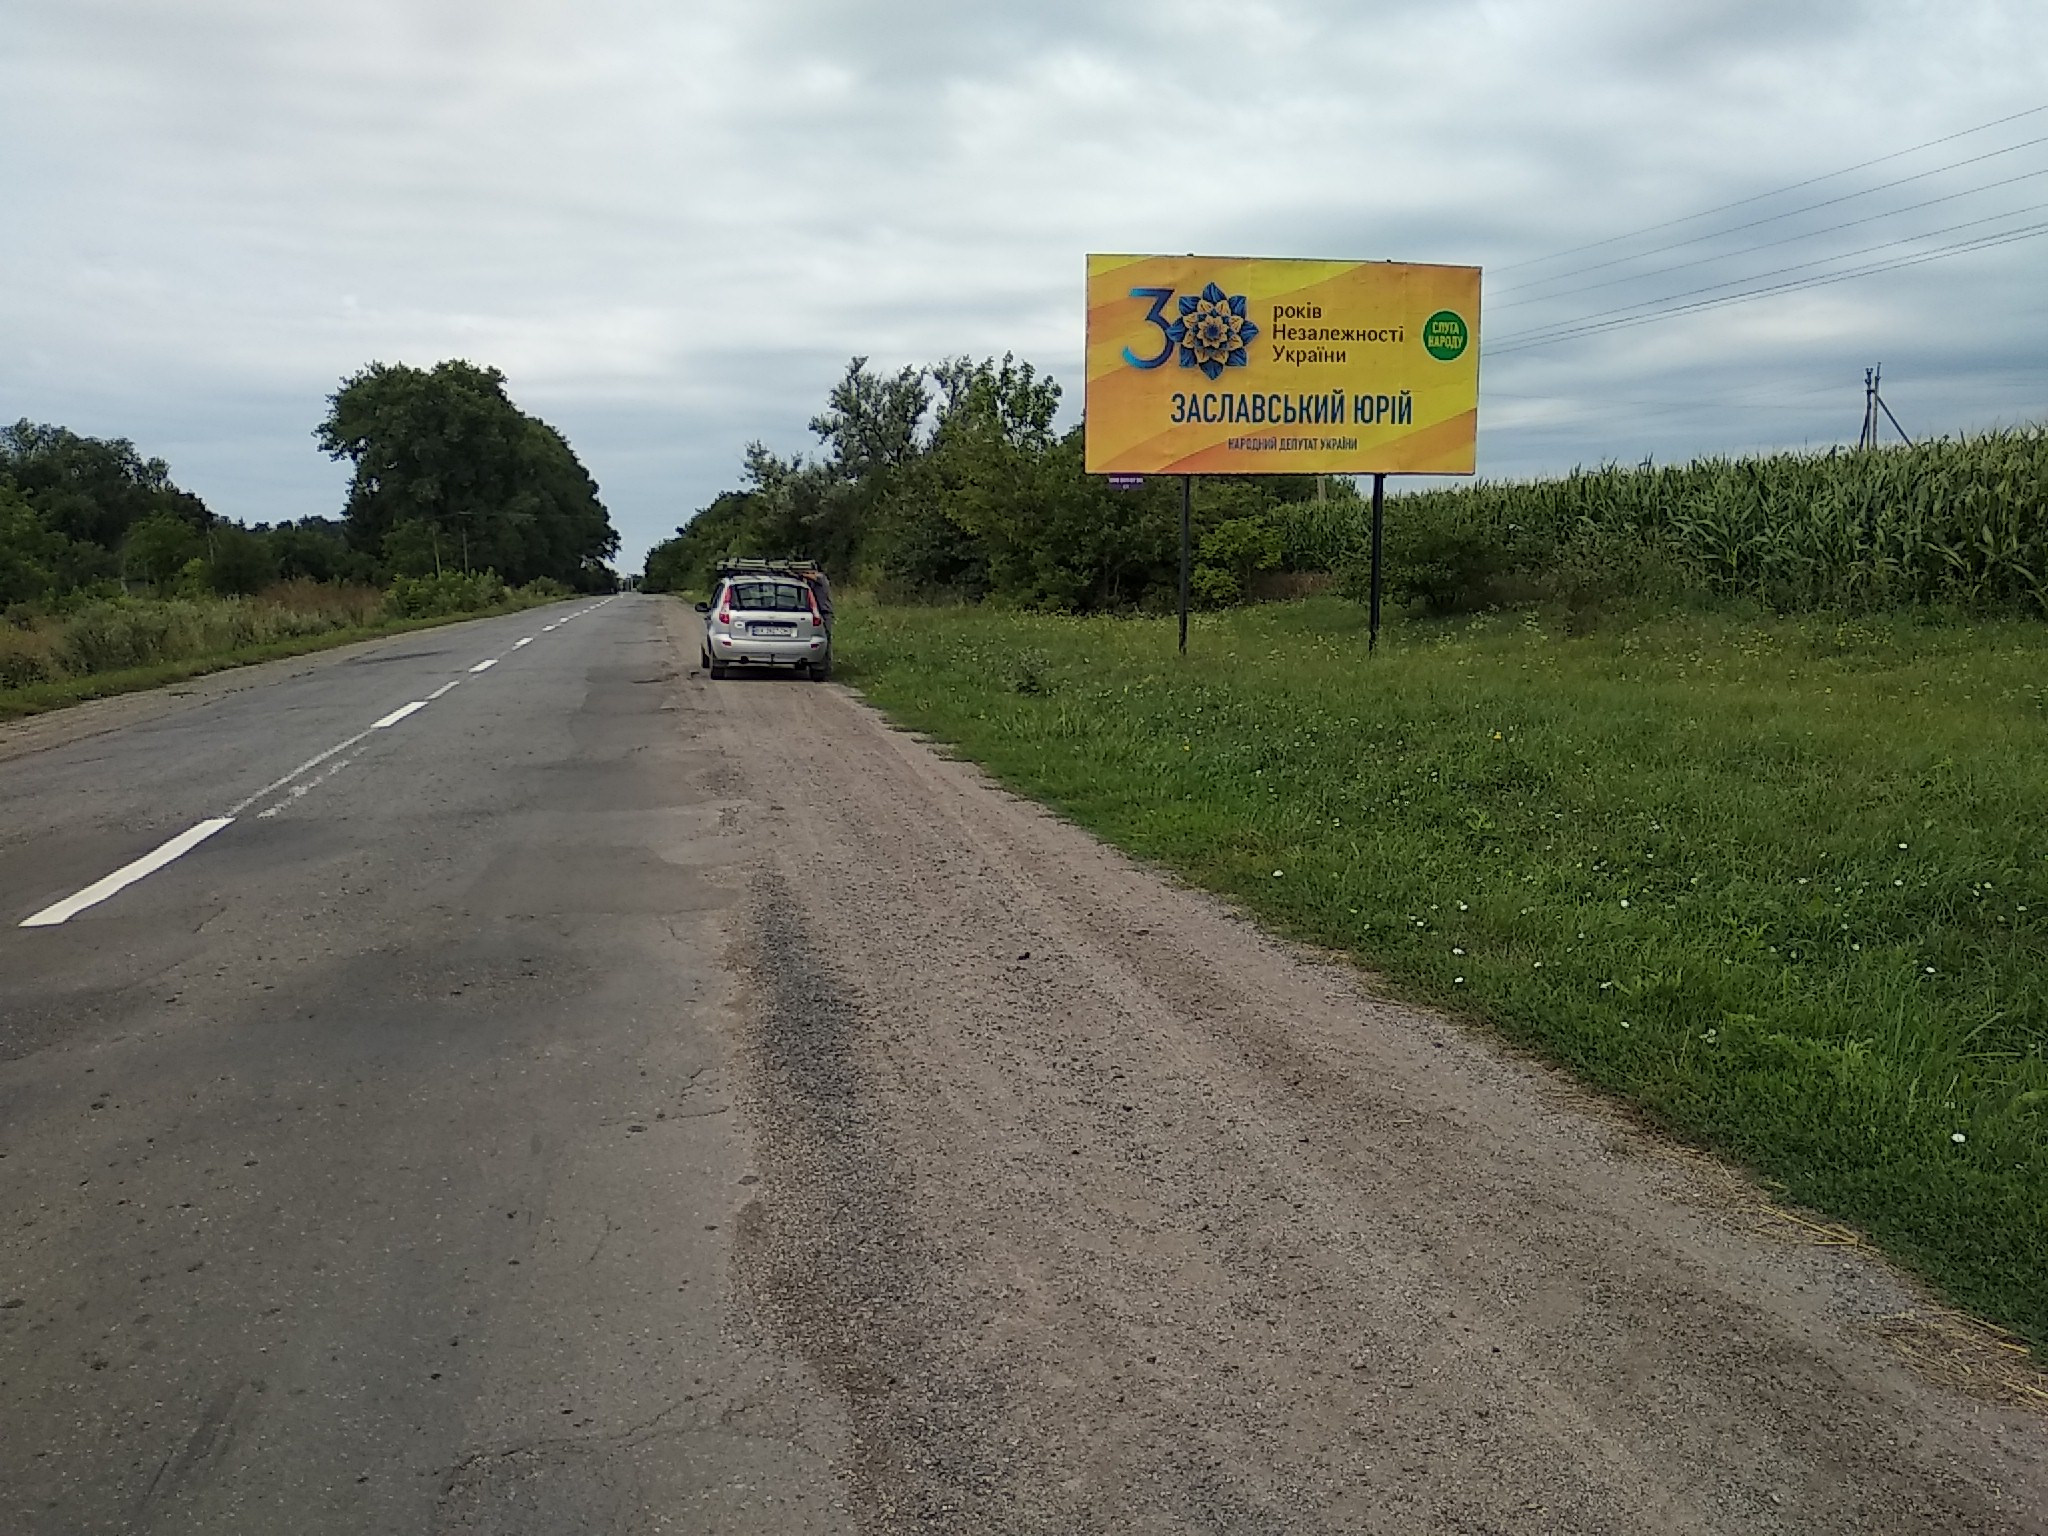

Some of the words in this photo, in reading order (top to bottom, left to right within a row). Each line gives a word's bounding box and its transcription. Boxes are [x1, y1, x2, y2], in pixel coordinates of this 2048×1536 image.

[1273, 301, 1322, 321] років
[1272, 323, 1404, 343] Незалежності
[1428, 335, 1464, 349] НАРОДУ
[1272, 345, 1346, 366] України
[1171, 390, 1345, 425] ЗАСЛАВСЬКИЙ
[1352, 390, 1413, 425] ЮРІЙ
[1228, 436, 1277, 451] НАРОДНИЙ
[1278, 437, 1318, 452] ДЕПУТАТ
[1319, 436, 1358, 451] УКРАЇНИ
